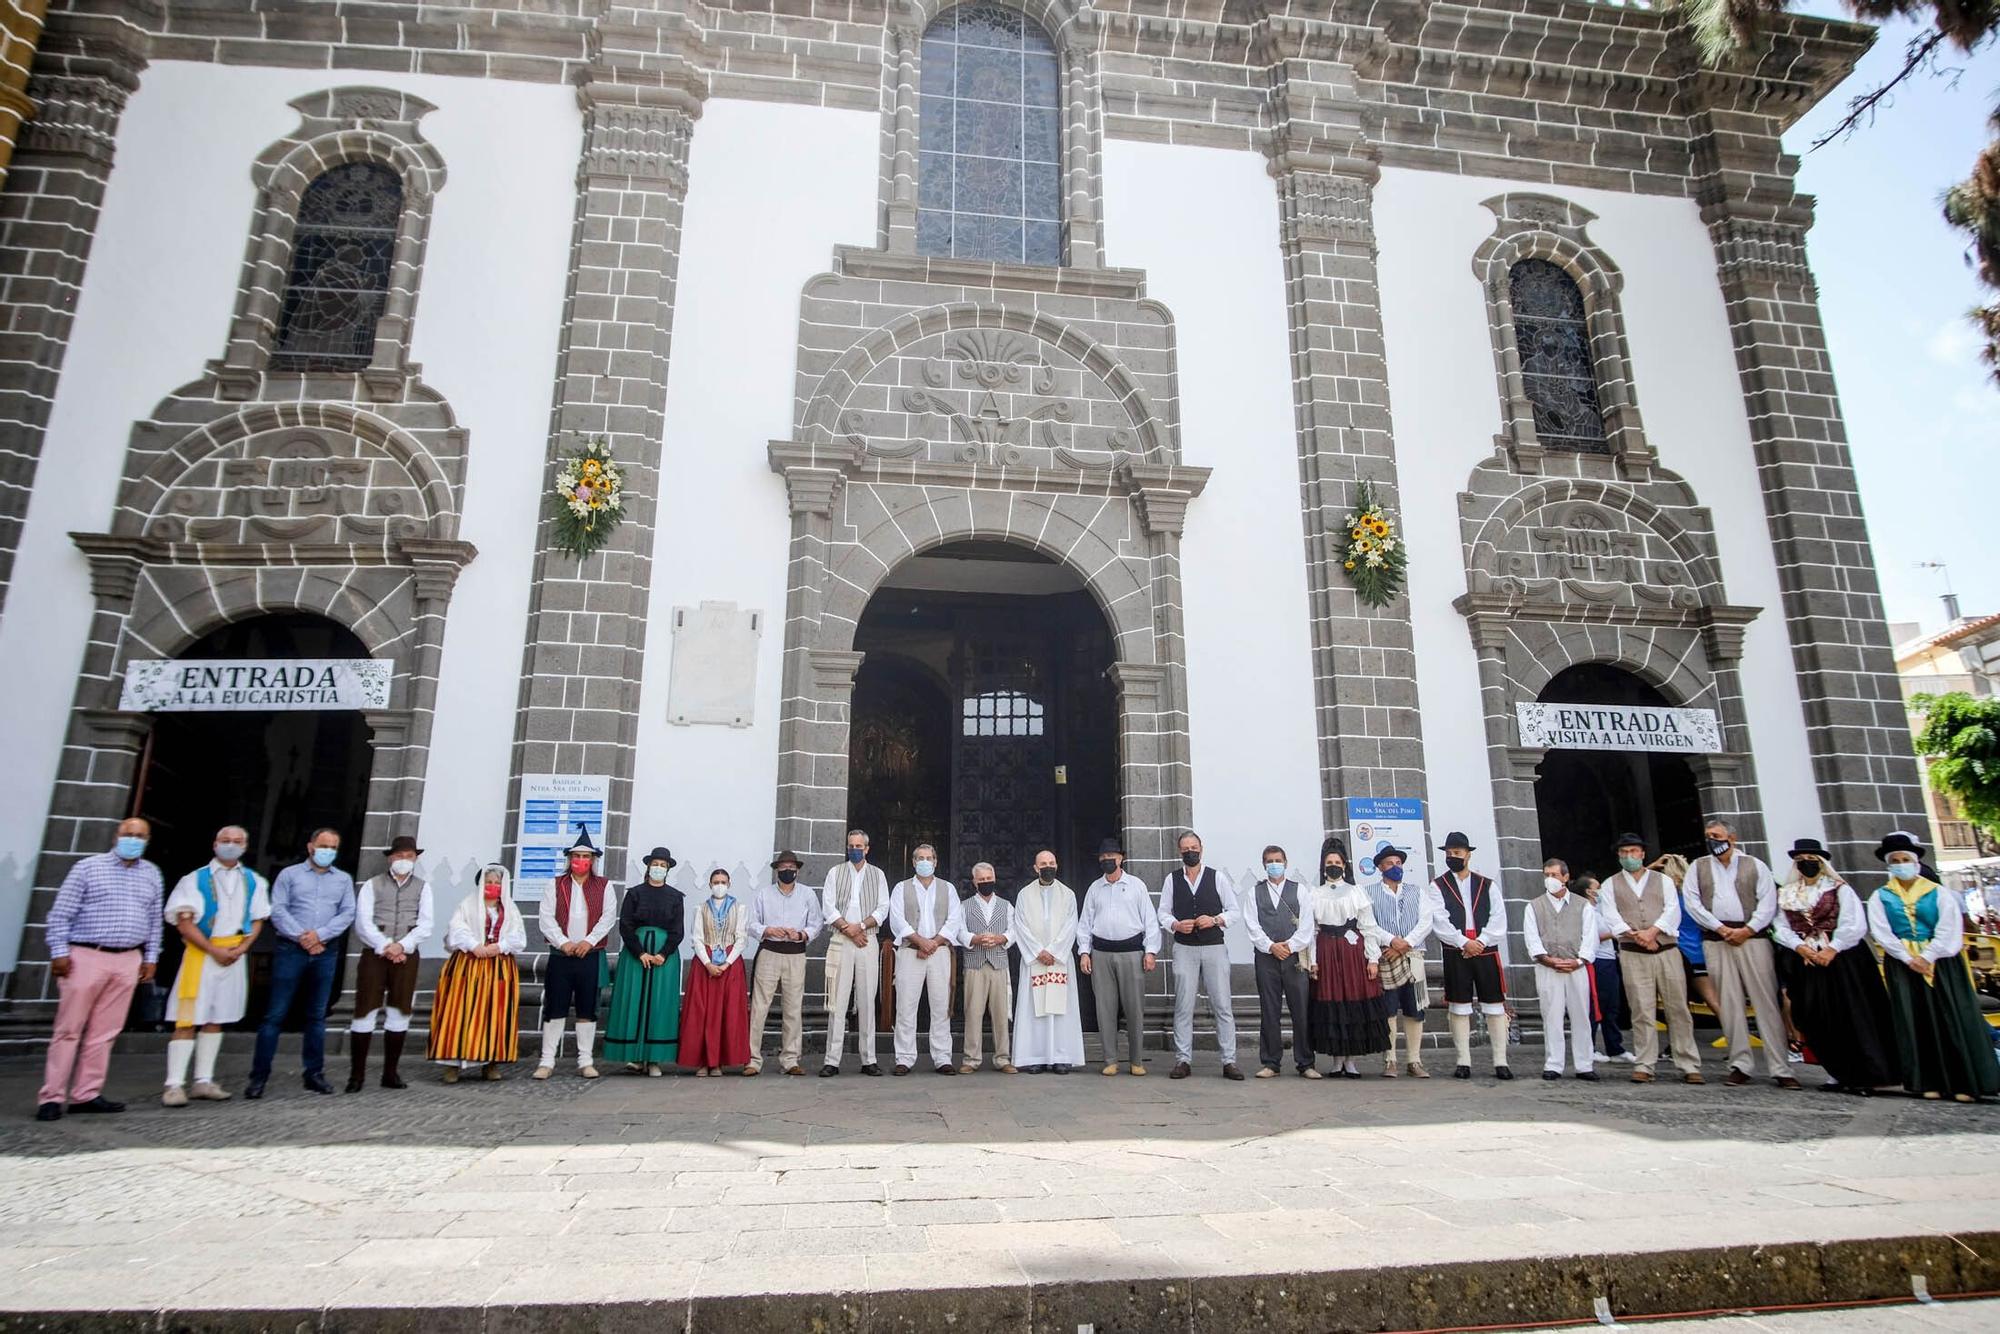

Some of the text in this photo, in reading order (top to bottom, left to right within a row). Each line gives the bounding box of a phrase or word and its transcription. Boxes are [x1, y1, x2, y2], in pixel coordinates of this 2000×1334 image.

[181, 666, 336, 688] ENTRADA
[171, 687, 340, 704] A LA EUCARISTÍA
[1559, 710, 1679, 733] ENTRADA
[1548, 730, 1694, 747] VISITA A LA VIRGEN
[1400, 807, 1416, 815] PINO
